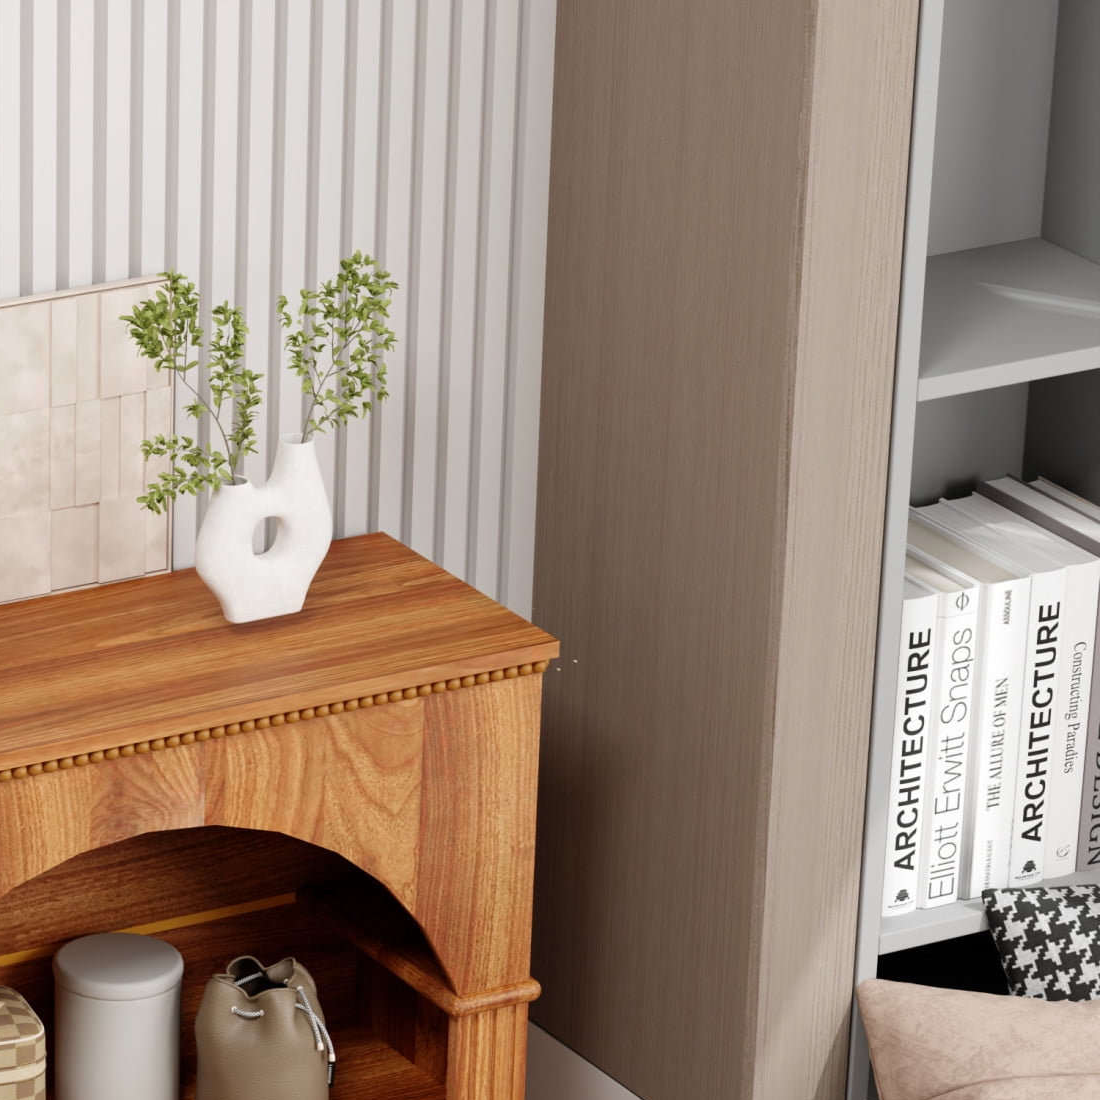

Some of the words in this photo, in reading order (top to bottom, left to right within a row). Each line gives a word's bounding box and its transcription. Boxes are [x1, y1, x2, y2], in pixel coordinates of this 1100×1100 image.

[940, 628, 974, 724] Snaps
[994, 677, 1009, 708] MEN
[1064, 641, 1087, 721] Constructing
[894, 628, 931, 871] ARCHITECTURE
[989, 728, 1005, 780] ALLURE
[993, 710, 1007, 728] OF
[1021, 601, 1060, 842] ARCHITECTURE
[1063, 722, 1081, 774] Paradies
[934, 732, 965, 815] Erwitt
[986, 782, 1001, 811] THE
[928, 822, 959, 900] Elliott
